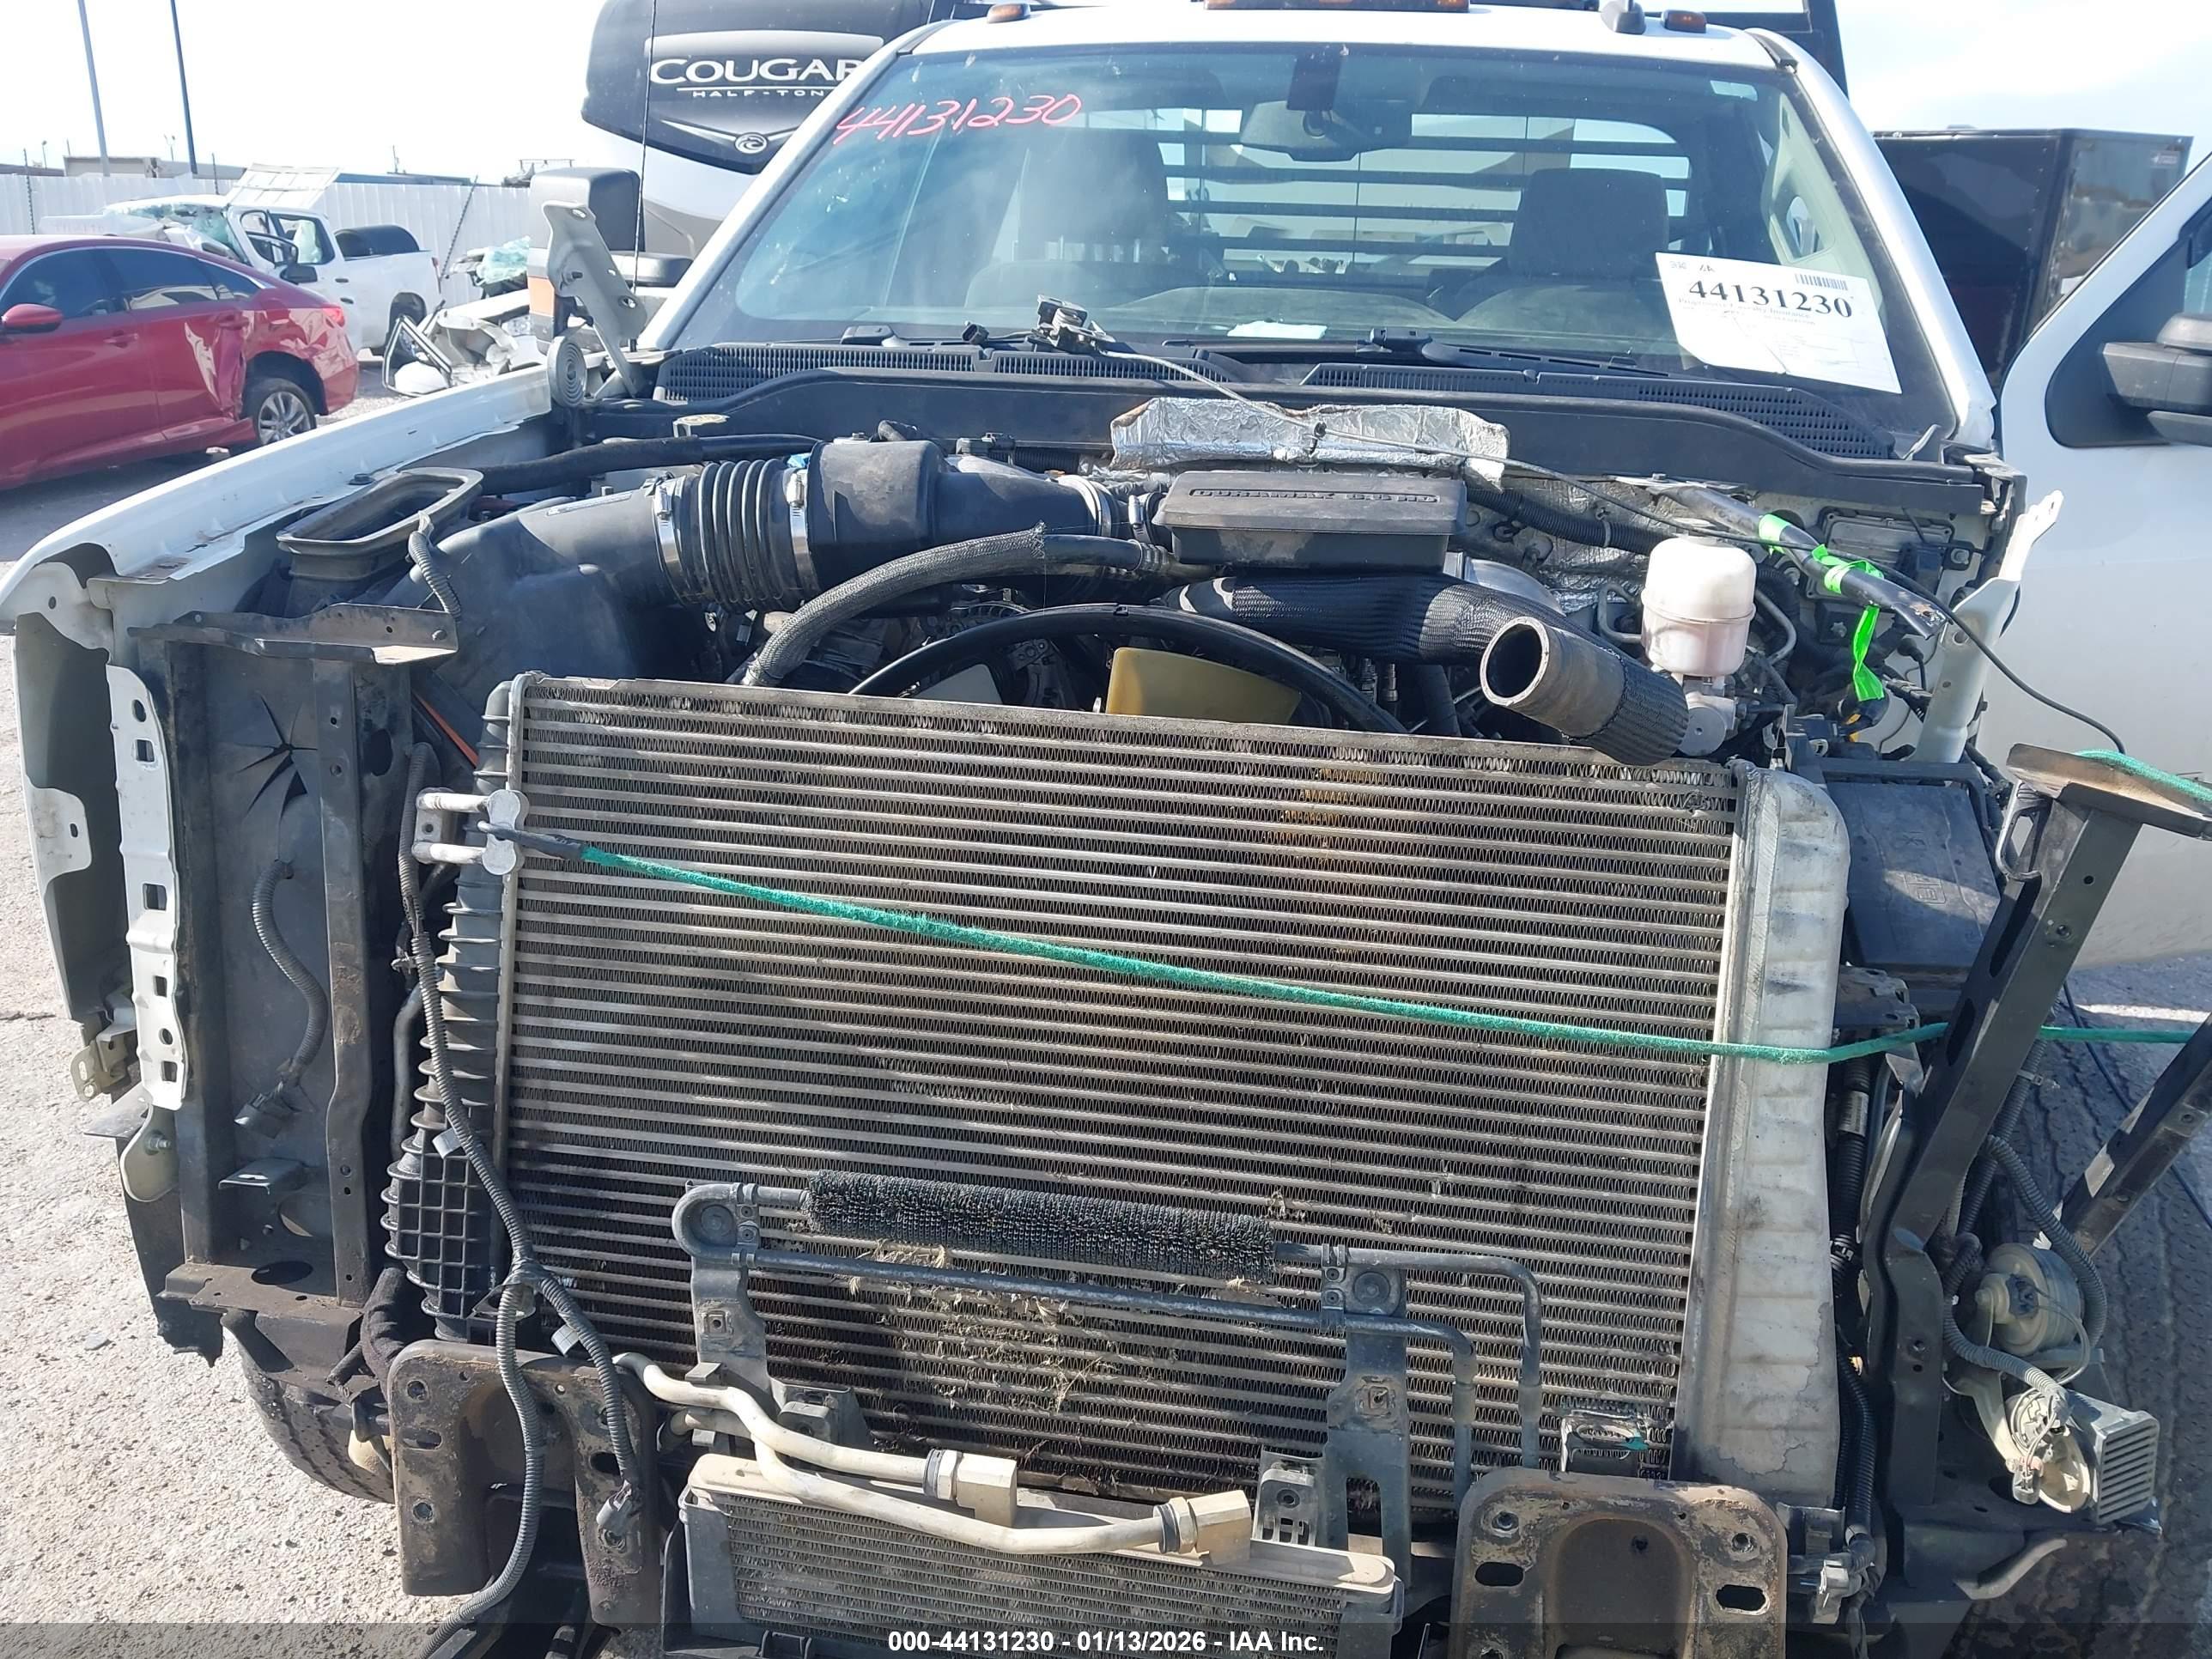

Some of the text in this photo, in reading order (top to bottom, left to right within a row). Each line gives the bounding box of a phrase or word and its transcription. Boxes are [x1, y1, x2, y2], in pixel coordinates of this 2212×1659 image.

[650, 58, 865, 84] COUGAR
[833, 94, 1082, 145] 44131230
[1689, 280, 1853, 318] 44131230
[1192, 489, 1335, 500] DURAMAX
